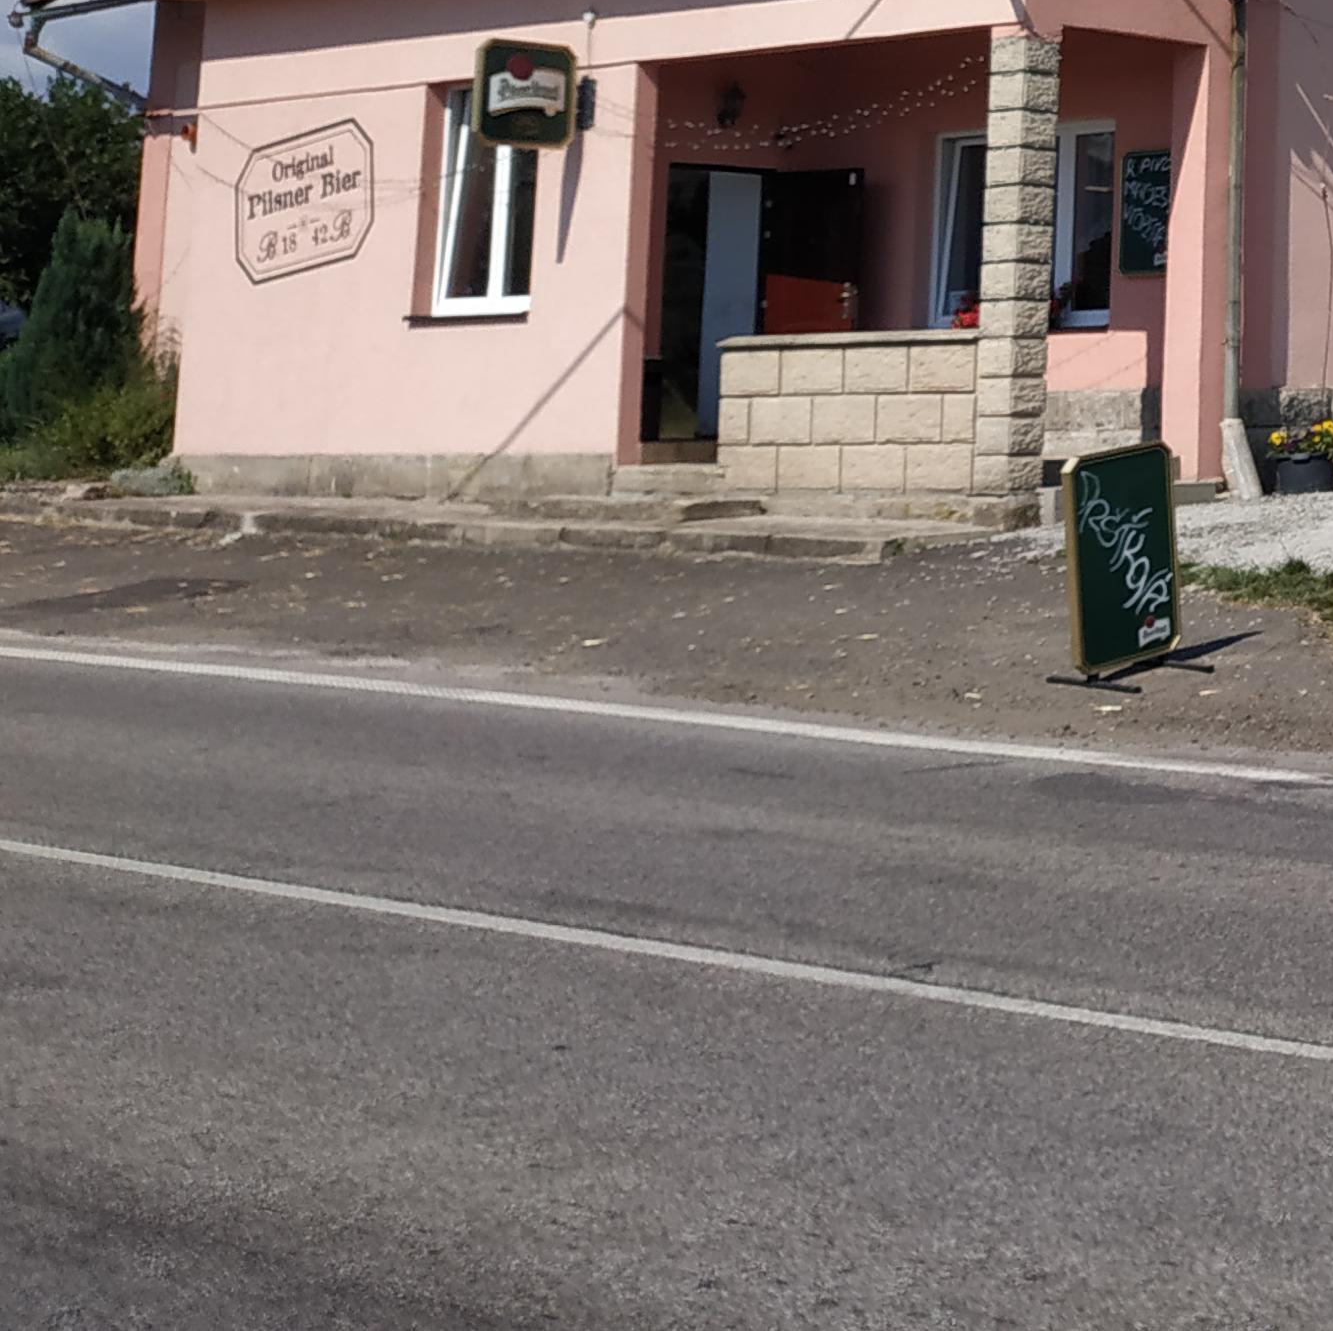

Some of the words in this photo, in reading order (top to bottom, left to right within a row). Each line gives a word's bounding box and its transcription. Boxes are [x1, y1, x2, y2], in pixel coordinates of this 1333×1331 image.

[271, 145, 335, 182] Original
[247, 184, 314, 220] Pilsner
[320, 169, 362, 199] Bier
[281, 233, 297, 255] 18
[311, 221, 329, 246] 42
